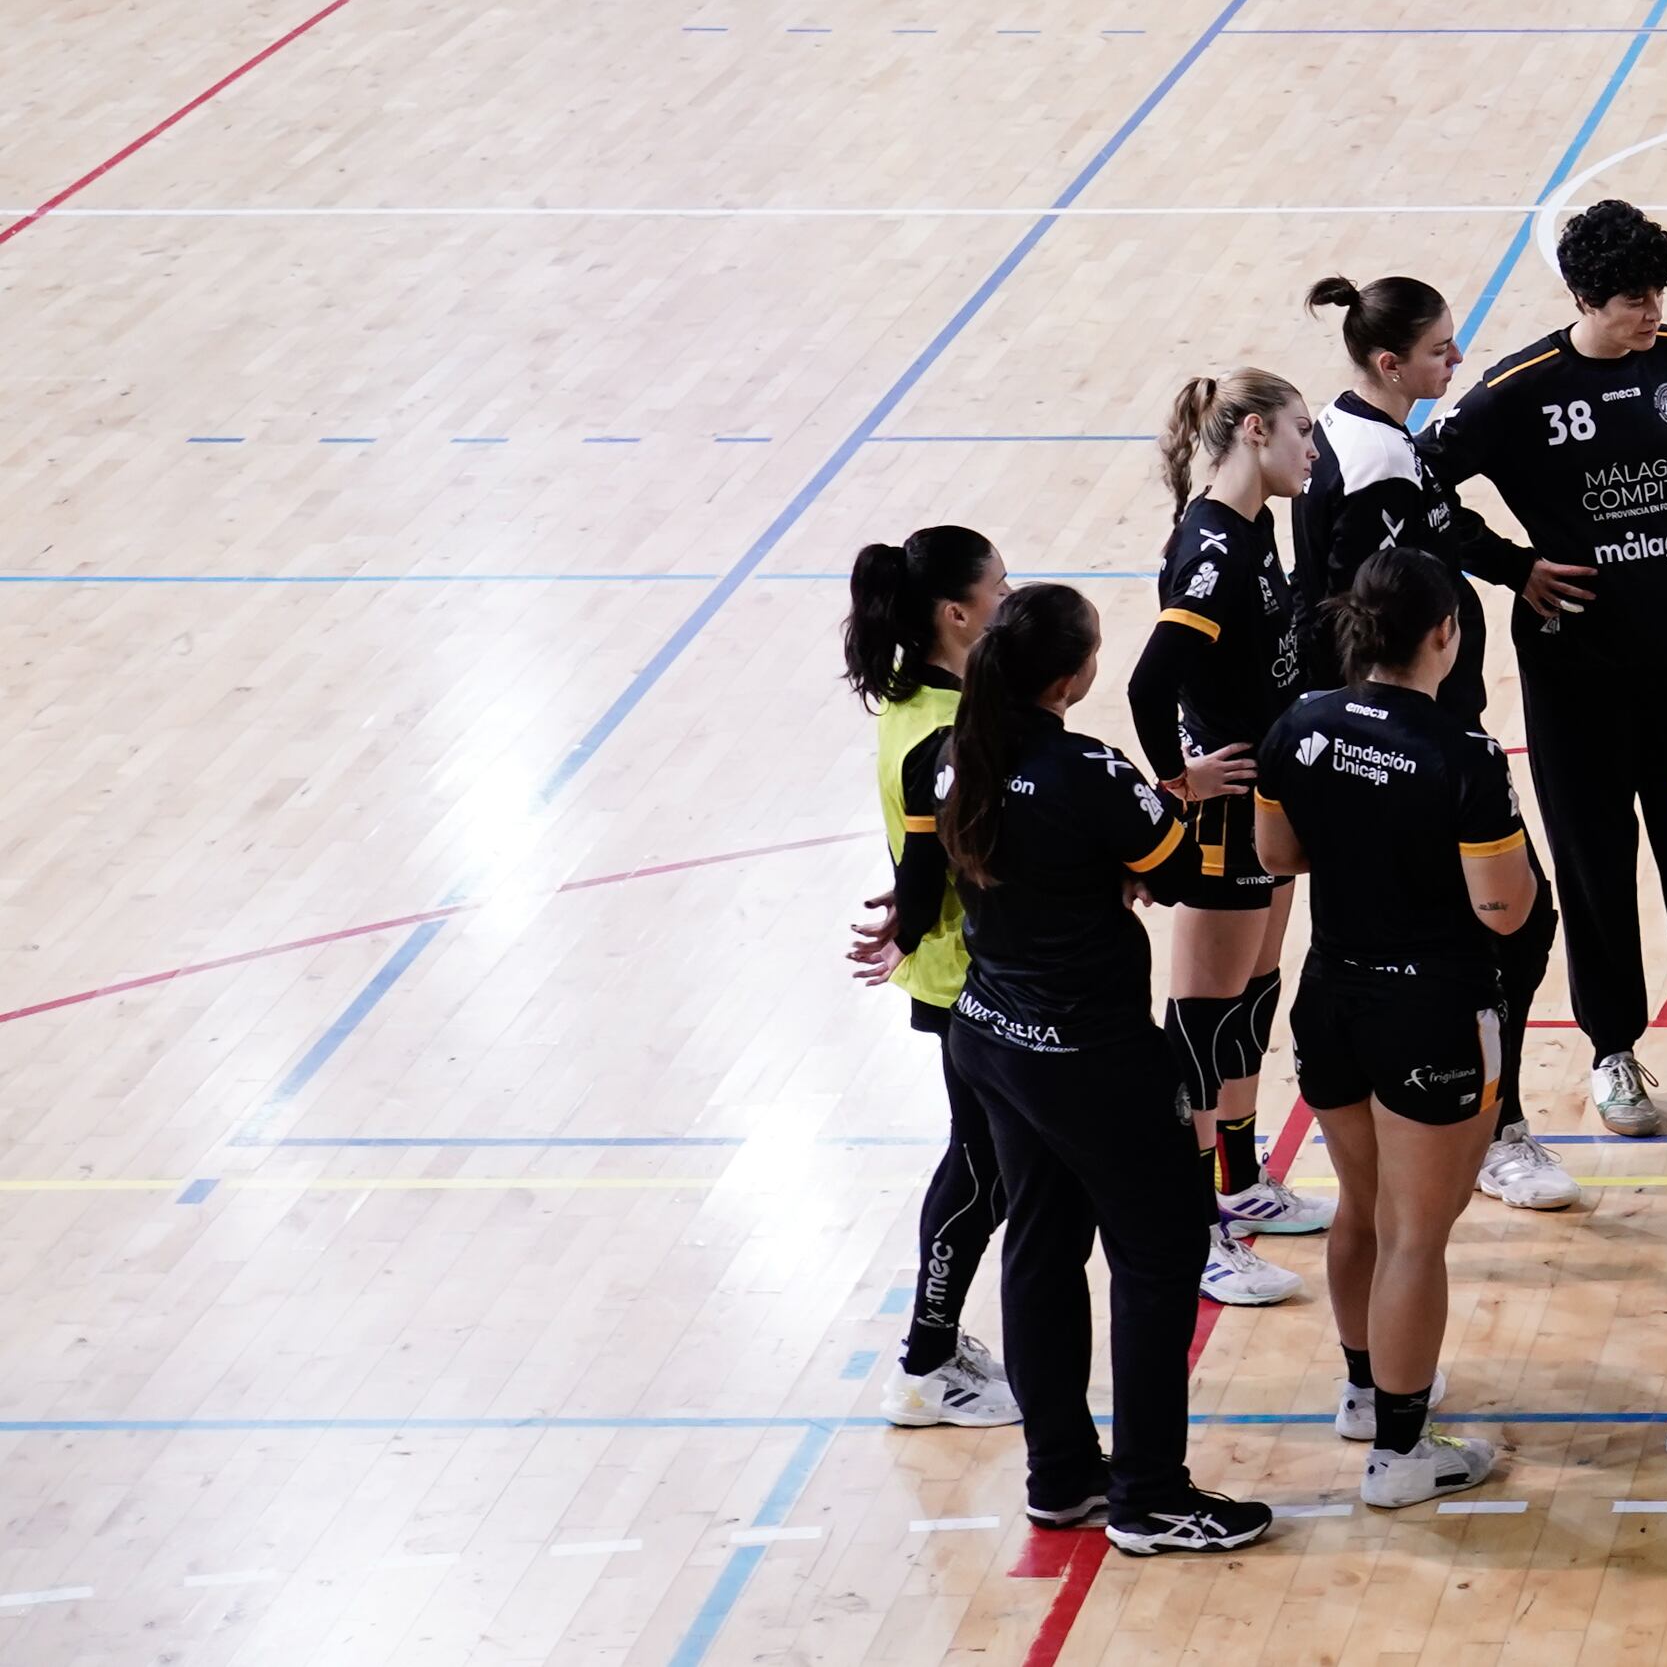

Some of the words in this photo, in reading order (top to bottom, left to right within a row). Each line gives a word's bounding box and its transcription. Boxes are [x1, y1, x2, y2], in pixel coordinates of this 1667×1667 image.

[1541, 400, 1597, 446] 38
[1593, 514, 1605, 522] LA
[1606, 506, 1650, 520] PROVINCIA
[1650, 505, 1660, 513] EN
[1332, 754, 1389, 786] Unicaja
[1334, 737, 1417, 774] Fundación
